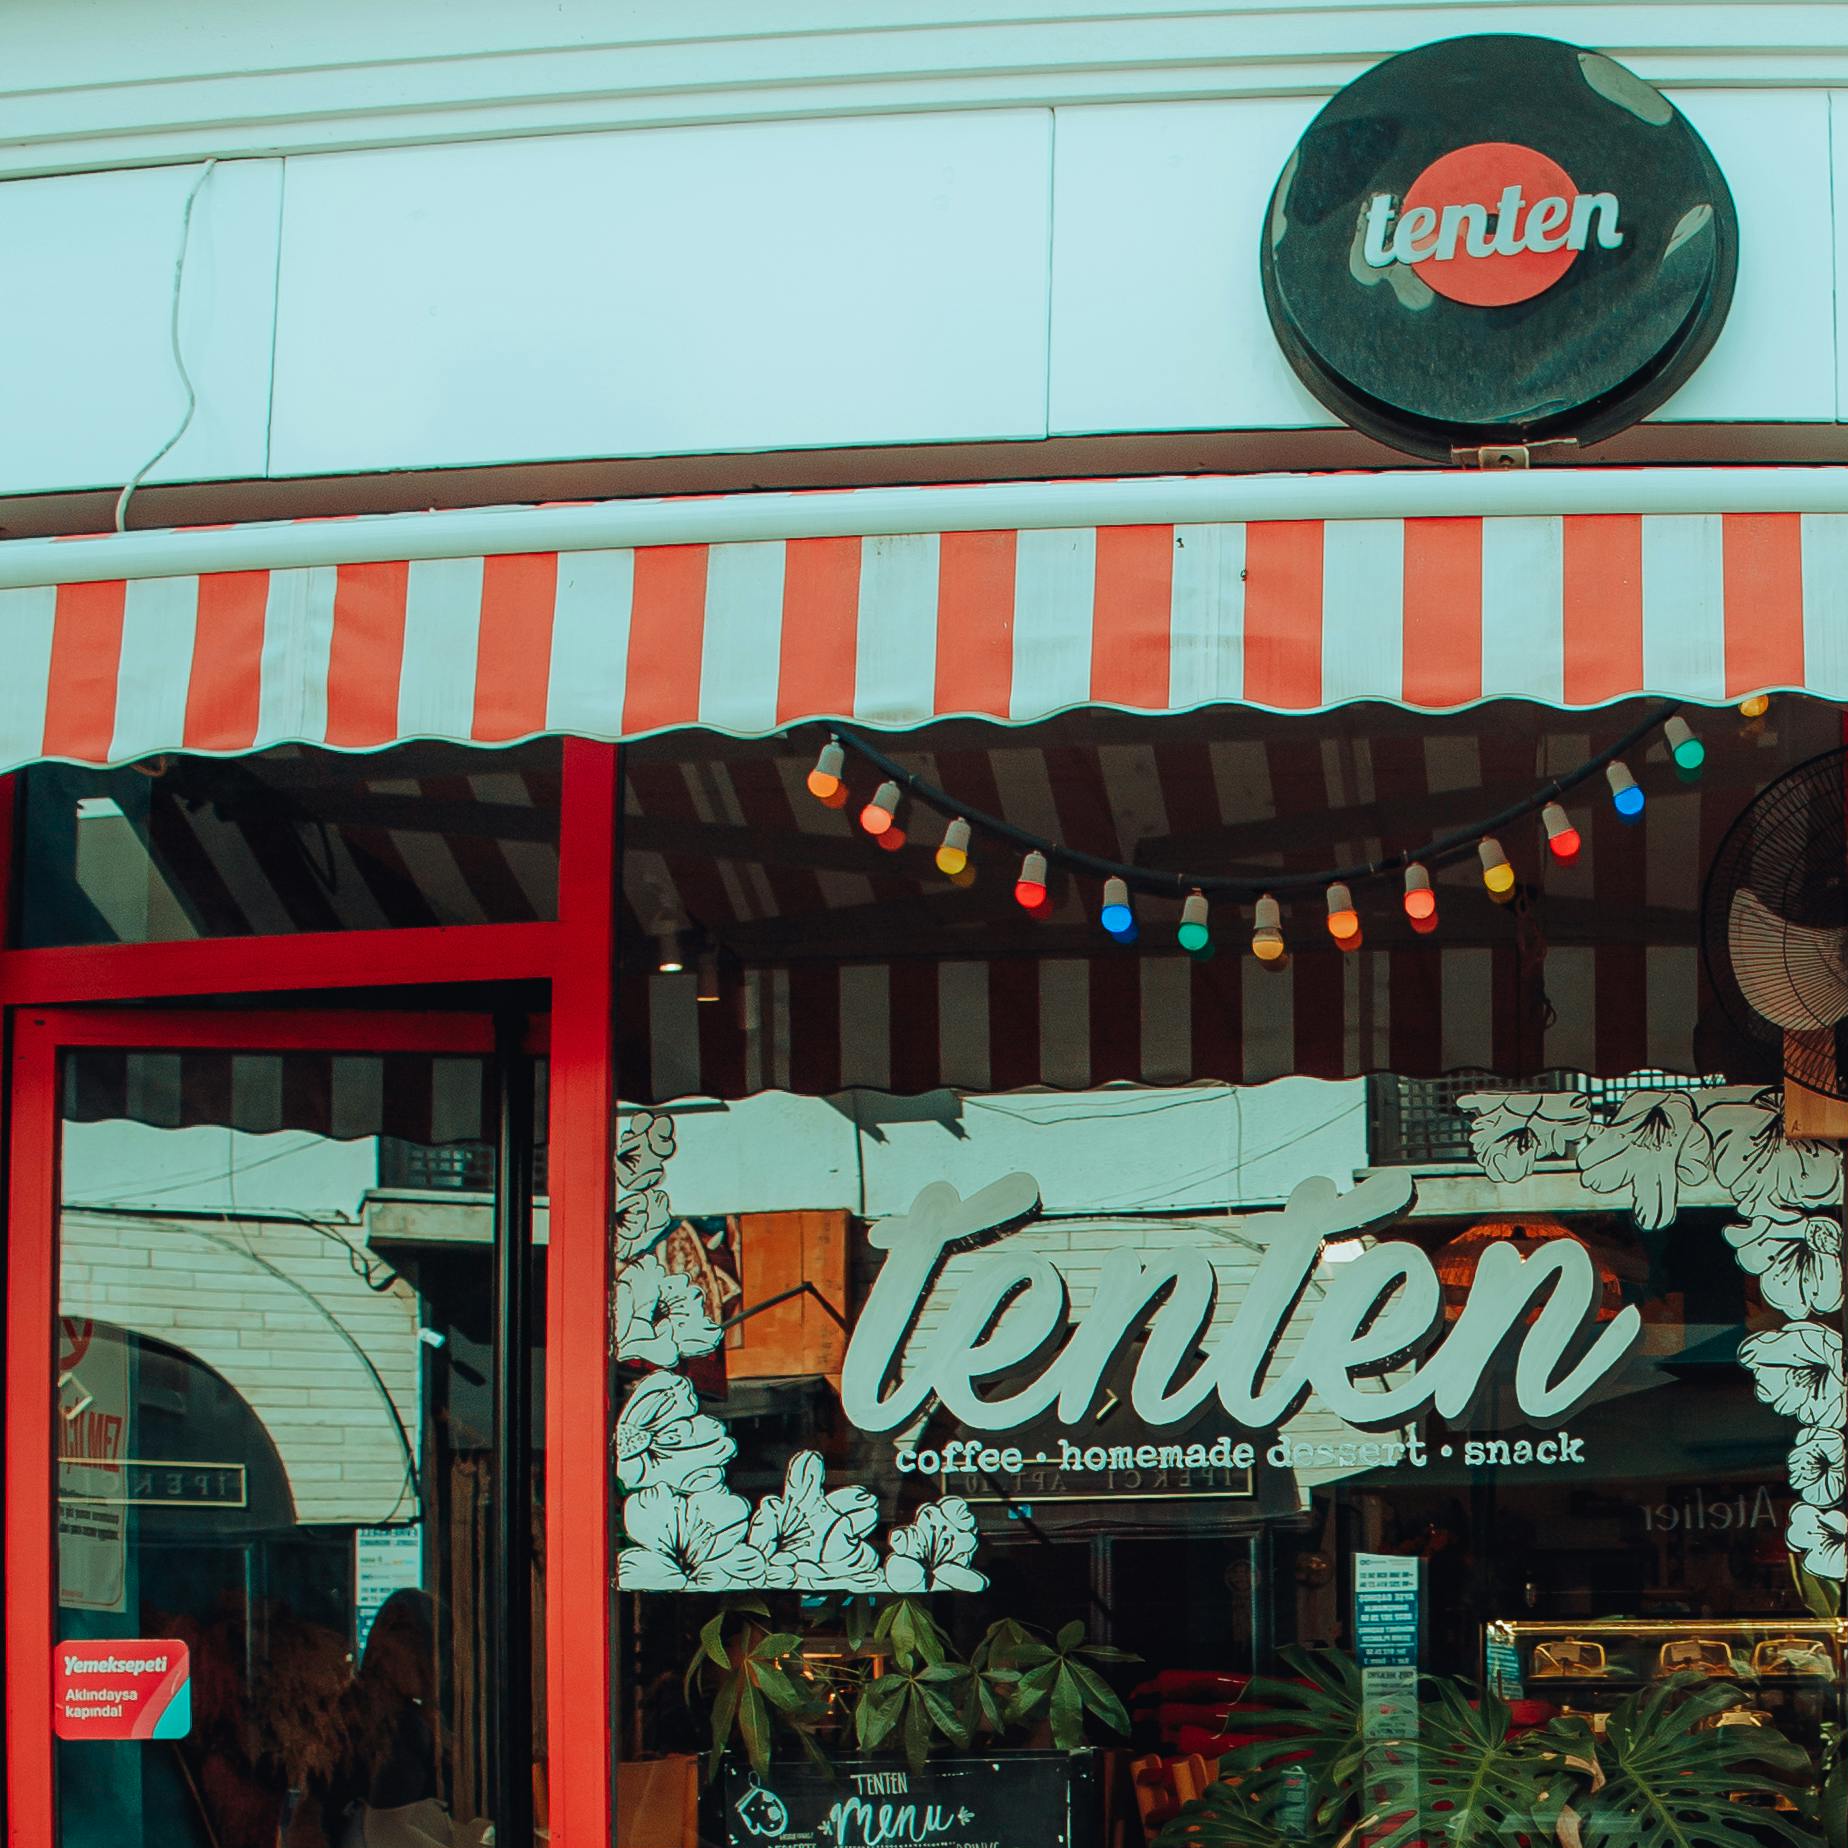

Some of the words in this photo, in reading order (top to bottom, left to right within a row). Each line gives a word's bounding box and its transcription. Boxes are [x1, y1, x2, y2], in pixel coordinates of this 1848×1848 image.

[1363, 185, 1623, 269] tenten
[895, 1440, 1024, 1473] coffee
[1058, 1437, 1255, 1472] homemade
[1266, 1434, 1428, 1468] dessert
[1464, 1432, 1585, 1466] snack
[64, 1655, 167, 1676] Yemeksepeti
[850, 1771, 908, 1795] TENTEN
